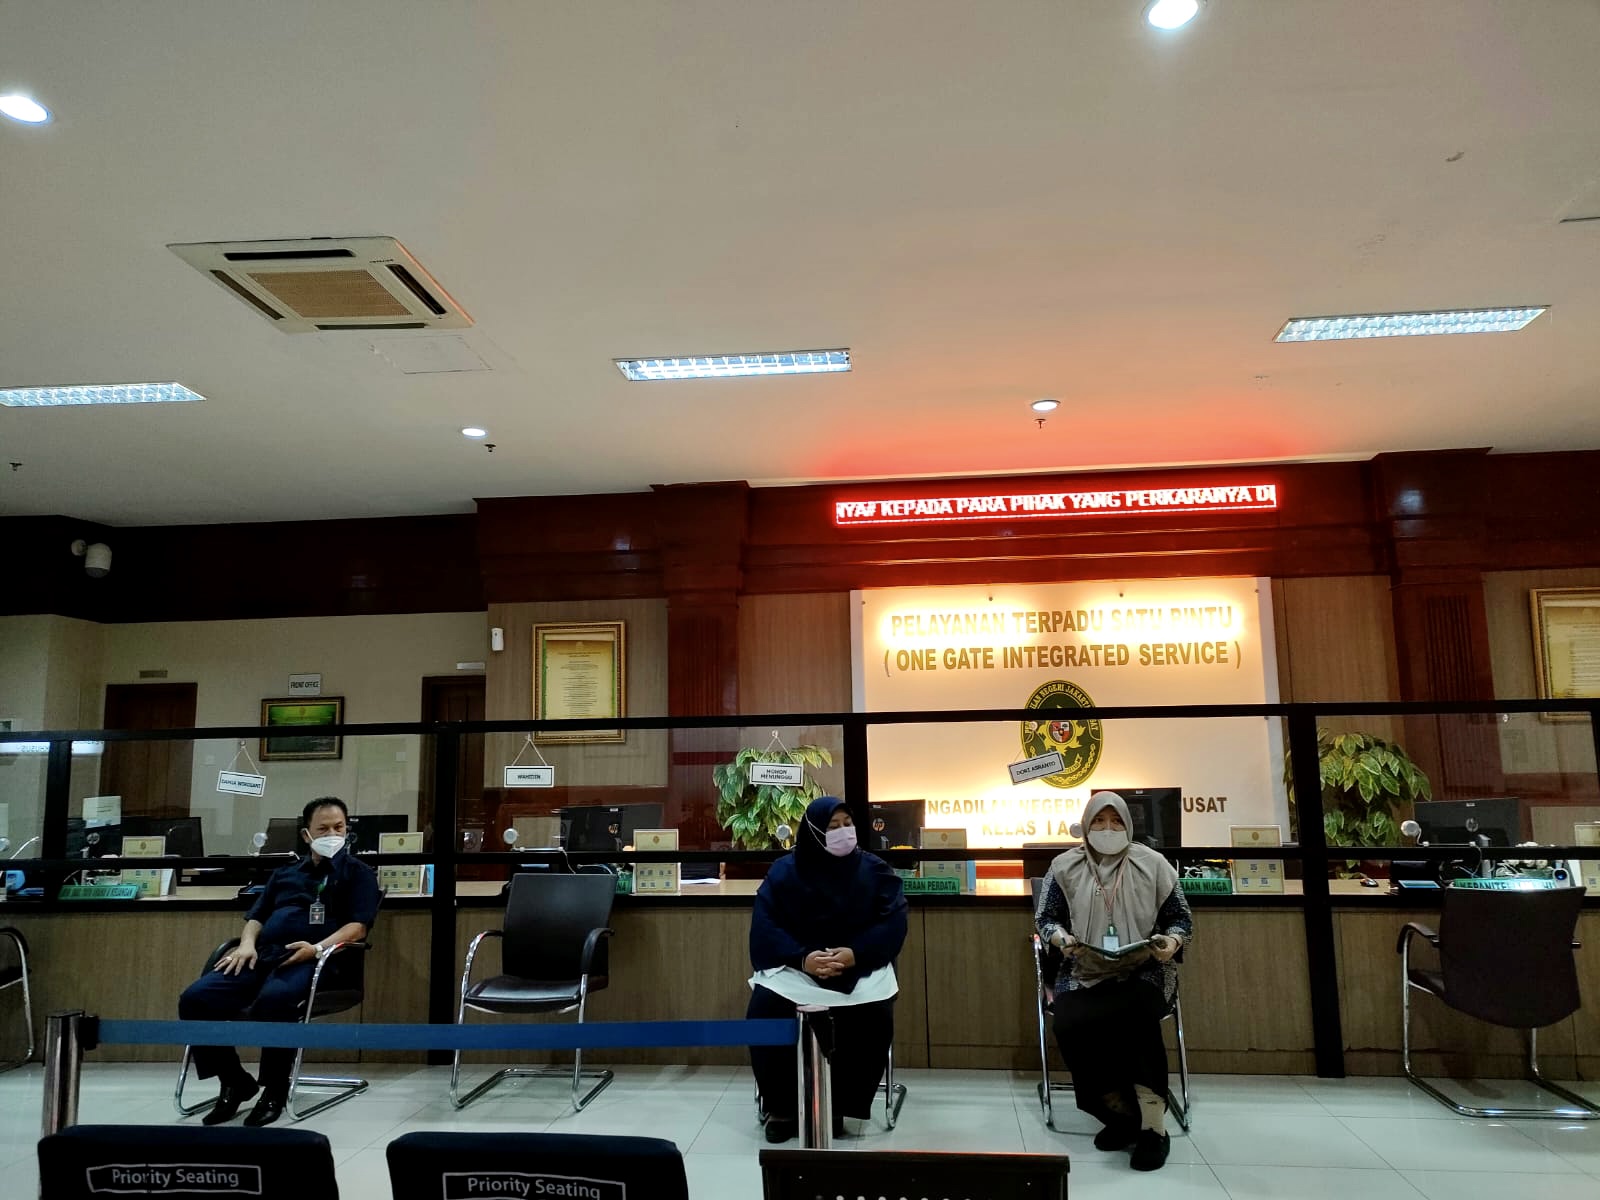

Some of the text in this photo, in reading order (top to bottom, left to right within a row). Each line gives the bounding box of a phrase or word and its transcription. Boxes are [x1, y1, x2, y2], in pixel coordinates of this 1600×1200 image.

[881, 500, 953, 517] KEPADA
[957, 497, 1007, 514] PARA
[1010, 494, 1065, 511] PIHAK
[1069, 492, 1121, 509] YANG
[1125, 488, 1254, 507] PERKARANYA
[891, 606, 1232, 637] PELAYANAN TERPADU SATU PINTU
[943, 647, 994, 670] GATE
[1003, 643, 1130, 669] INTEGRATED
[1139, 641, 1229, 667] SERVICE
[927, 799, 1012, 816] NGADILAN
[1183, 796, 1228, 813] USAT
[112, 1168, 239, 1188] Priority Seating
[468, 1177, 600, 1200] Priority Seating
